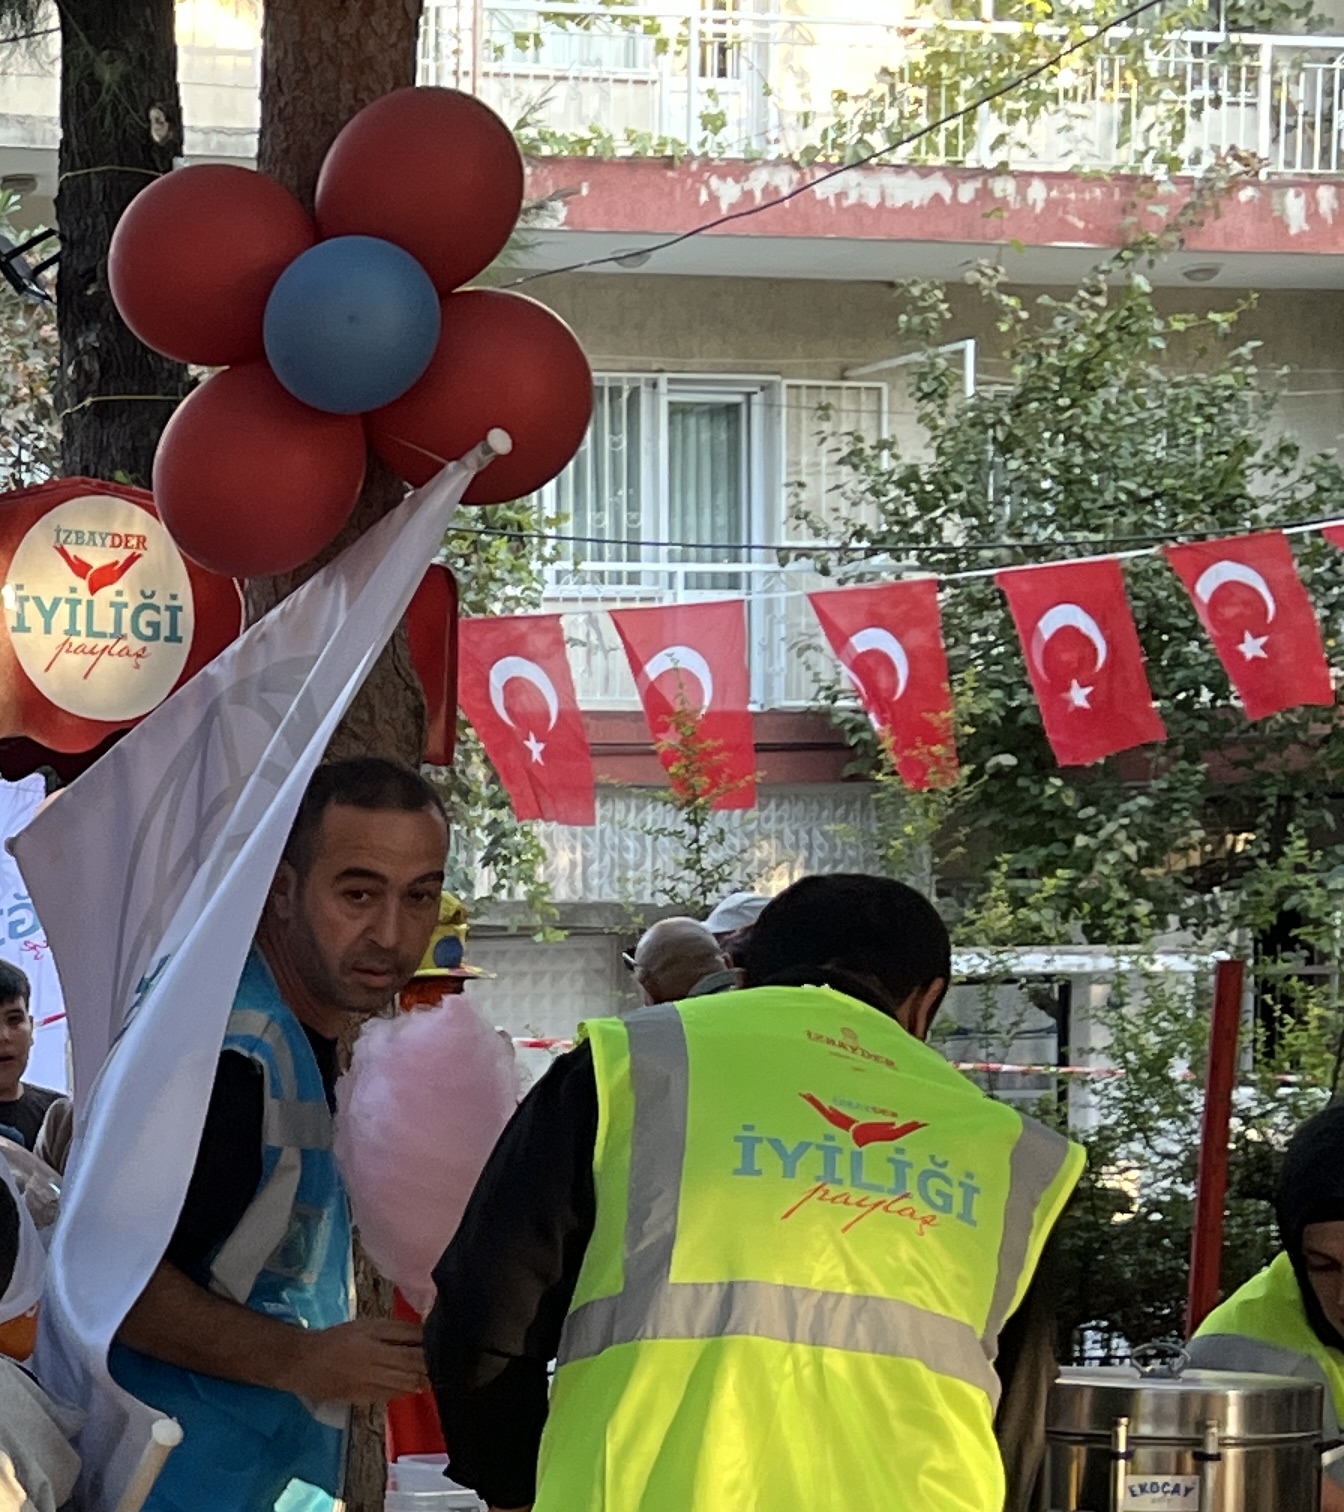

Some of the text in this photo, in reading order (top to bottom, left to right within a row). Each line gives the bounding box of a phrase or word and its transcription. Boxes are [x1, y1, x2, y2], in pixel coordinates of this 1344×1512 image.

[54, 525, 148, 551] İZBAYDER
[11, 584, 183, 644] İYİLİĞİ
[44, 634, 152, 680] paylaş
[732, 1124, 981, 1228] İYİLİĞİ
[780, 1181, 941, 1237] paylaş
